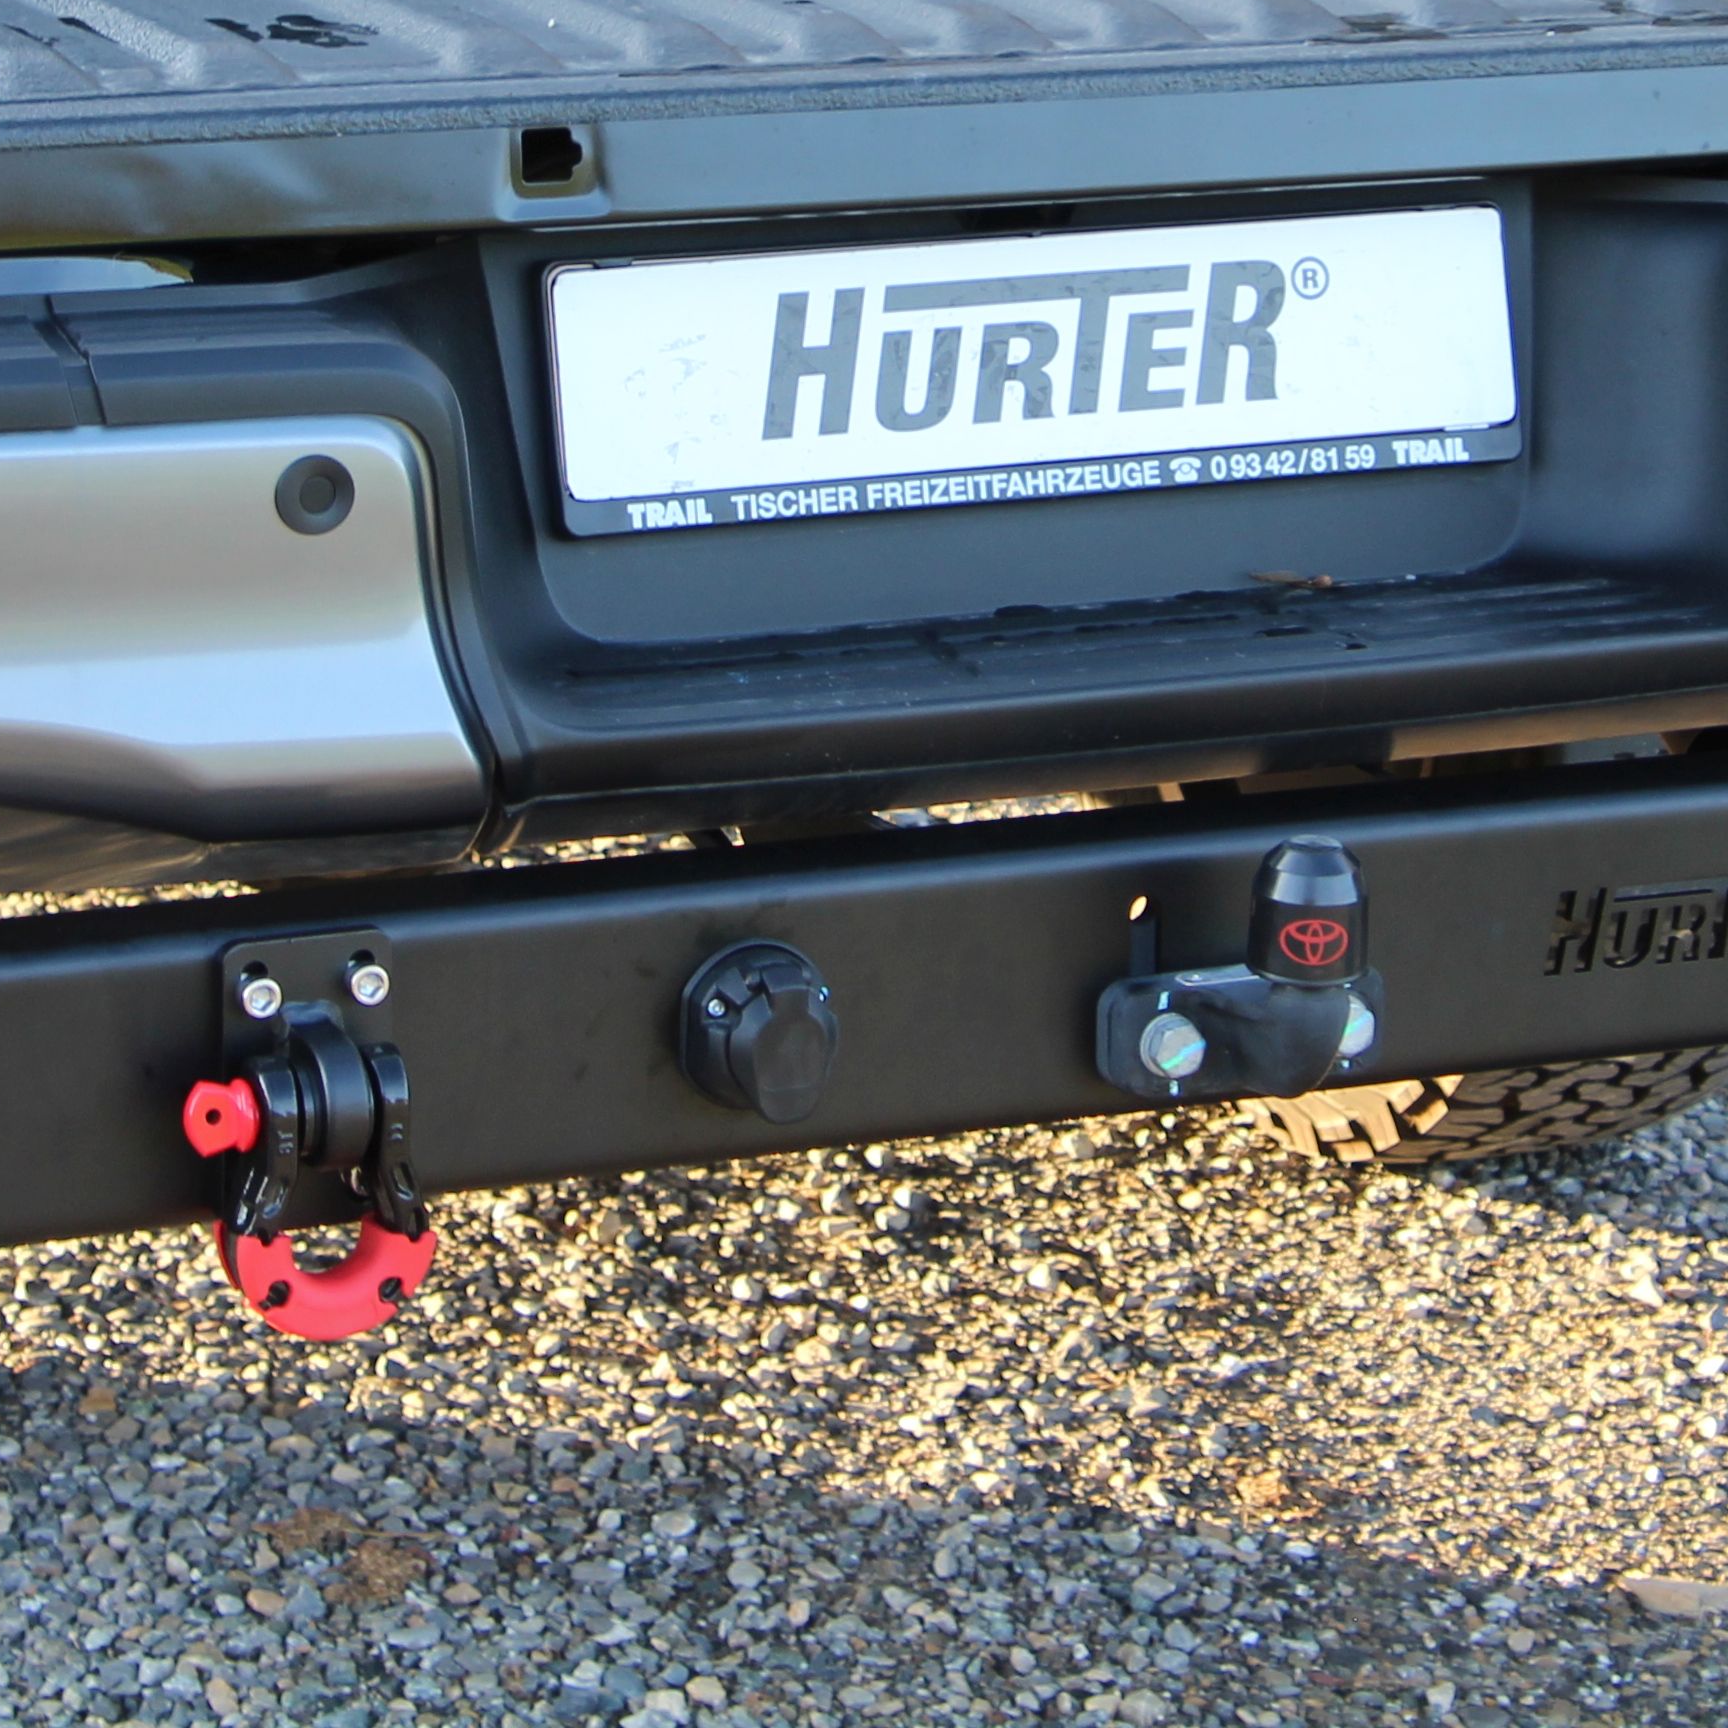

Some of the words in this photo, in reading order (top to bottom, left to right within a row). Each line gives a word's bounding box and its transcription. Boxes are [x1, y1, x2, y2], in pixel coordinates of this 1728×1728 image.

[627, 498, 712, 529] TRAIL
[730, 485, 859, 520] TISCHER
[866, 459, 1161, 510] FREIZEITFAHRZEUGE
[1391, 437, 1469, 465] TRAIL
